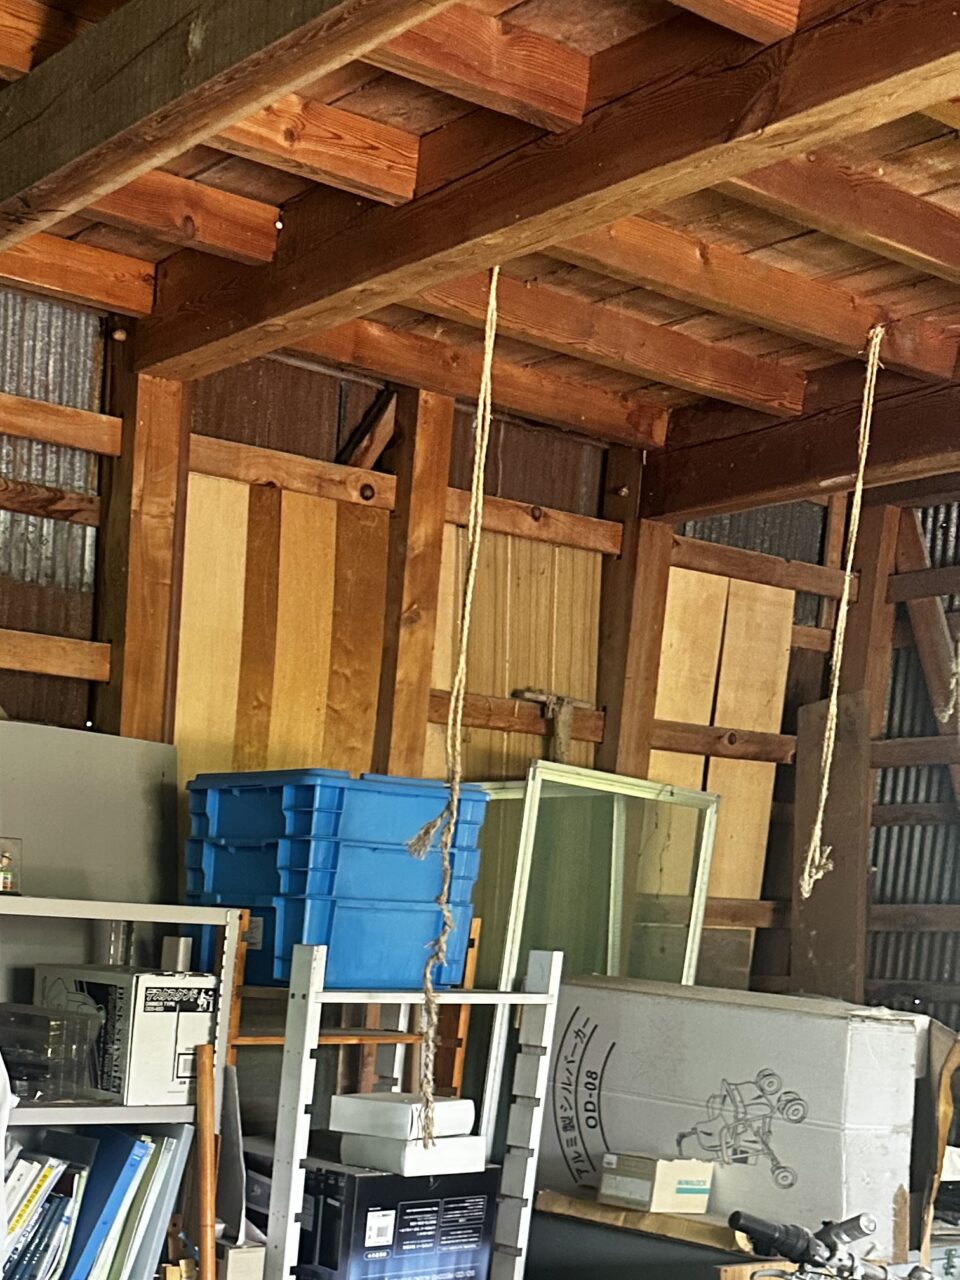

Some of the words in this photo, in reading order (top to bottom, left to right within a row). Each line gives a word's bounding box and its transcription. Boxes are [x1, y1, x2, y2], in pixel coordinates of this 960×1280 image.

[559, 1016, 591, 1179] アルミ製シルバーカー
[584, 1070, 599, 1129] OD-08
